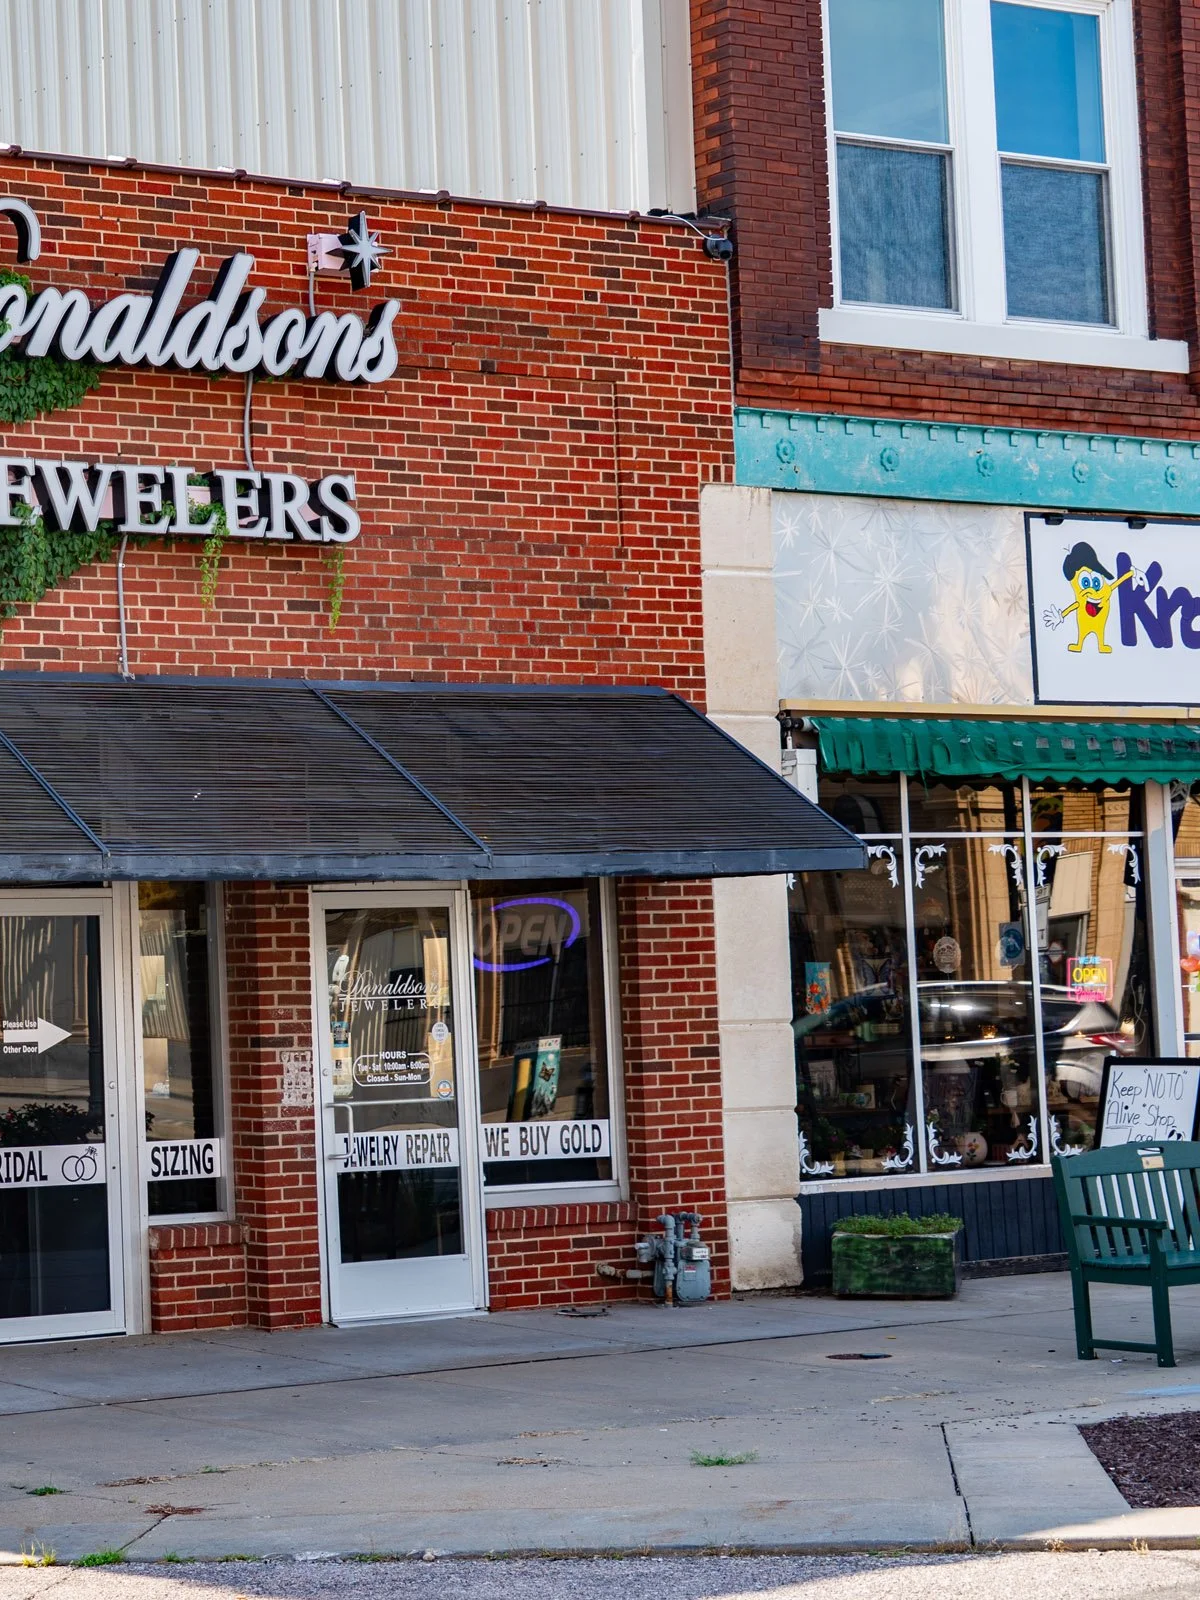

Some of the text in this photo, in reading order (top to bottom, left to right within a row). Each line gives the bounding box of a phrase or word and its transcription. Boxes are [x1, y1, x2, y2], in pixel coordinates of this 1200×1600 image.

[473, 914, 568, 957] OPEN
[1072, 967, 1107, 983] OPEN
[2, 1019, 37, 1029] Please Use
[3, 1045, 38, 1054] Other Door
[379, 1051, 407, 1060] HOURS
[366, 1074, 389, 1083] Closed
[393, 1073, 422, 1082] Sun-Mon
[1110, 1070, 1143, 1105] Keep
[343, 1132, 453, 1168] JEWELRY REPAIR
[484, 1123, 602, 1158] WE BUY GOLD
[151, 1143, 214, 1177] SIZING
